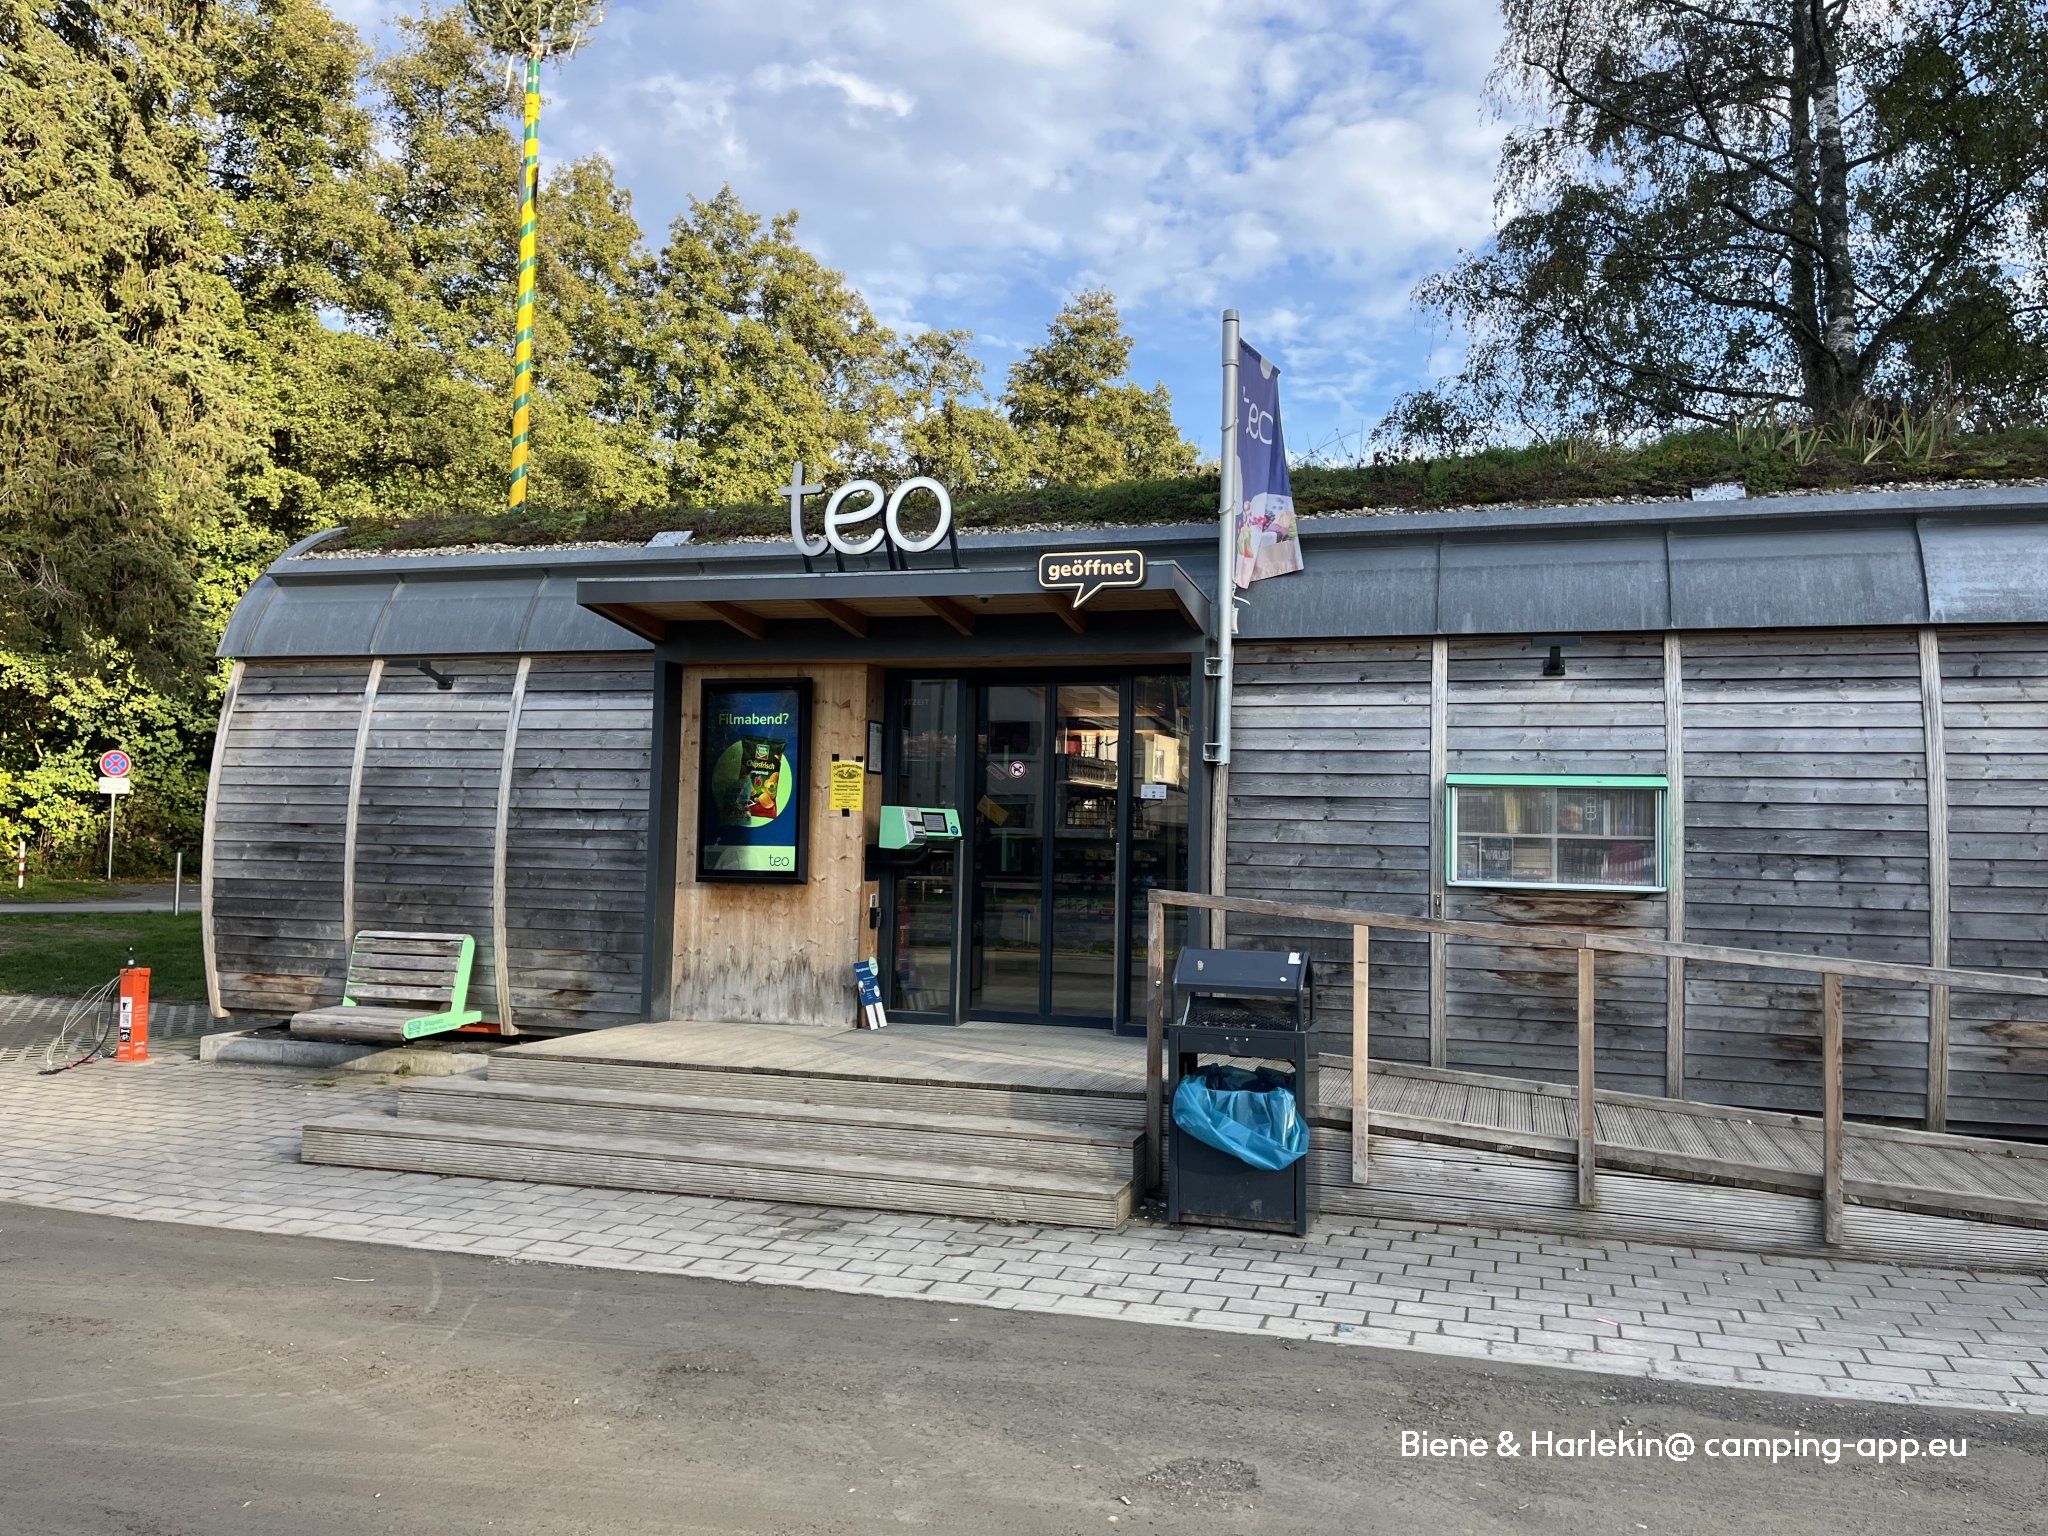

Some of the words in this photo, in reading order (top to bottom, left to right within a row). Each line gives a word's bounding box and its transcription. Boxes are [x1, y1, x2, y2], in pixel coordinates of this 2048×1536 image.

[778, 461, 952, 557] teo
[1048, 559, 1133, 580] geöffnet
[719, 713, 789, 725] Filmabend?
[768, 854, 789, 866] teo
